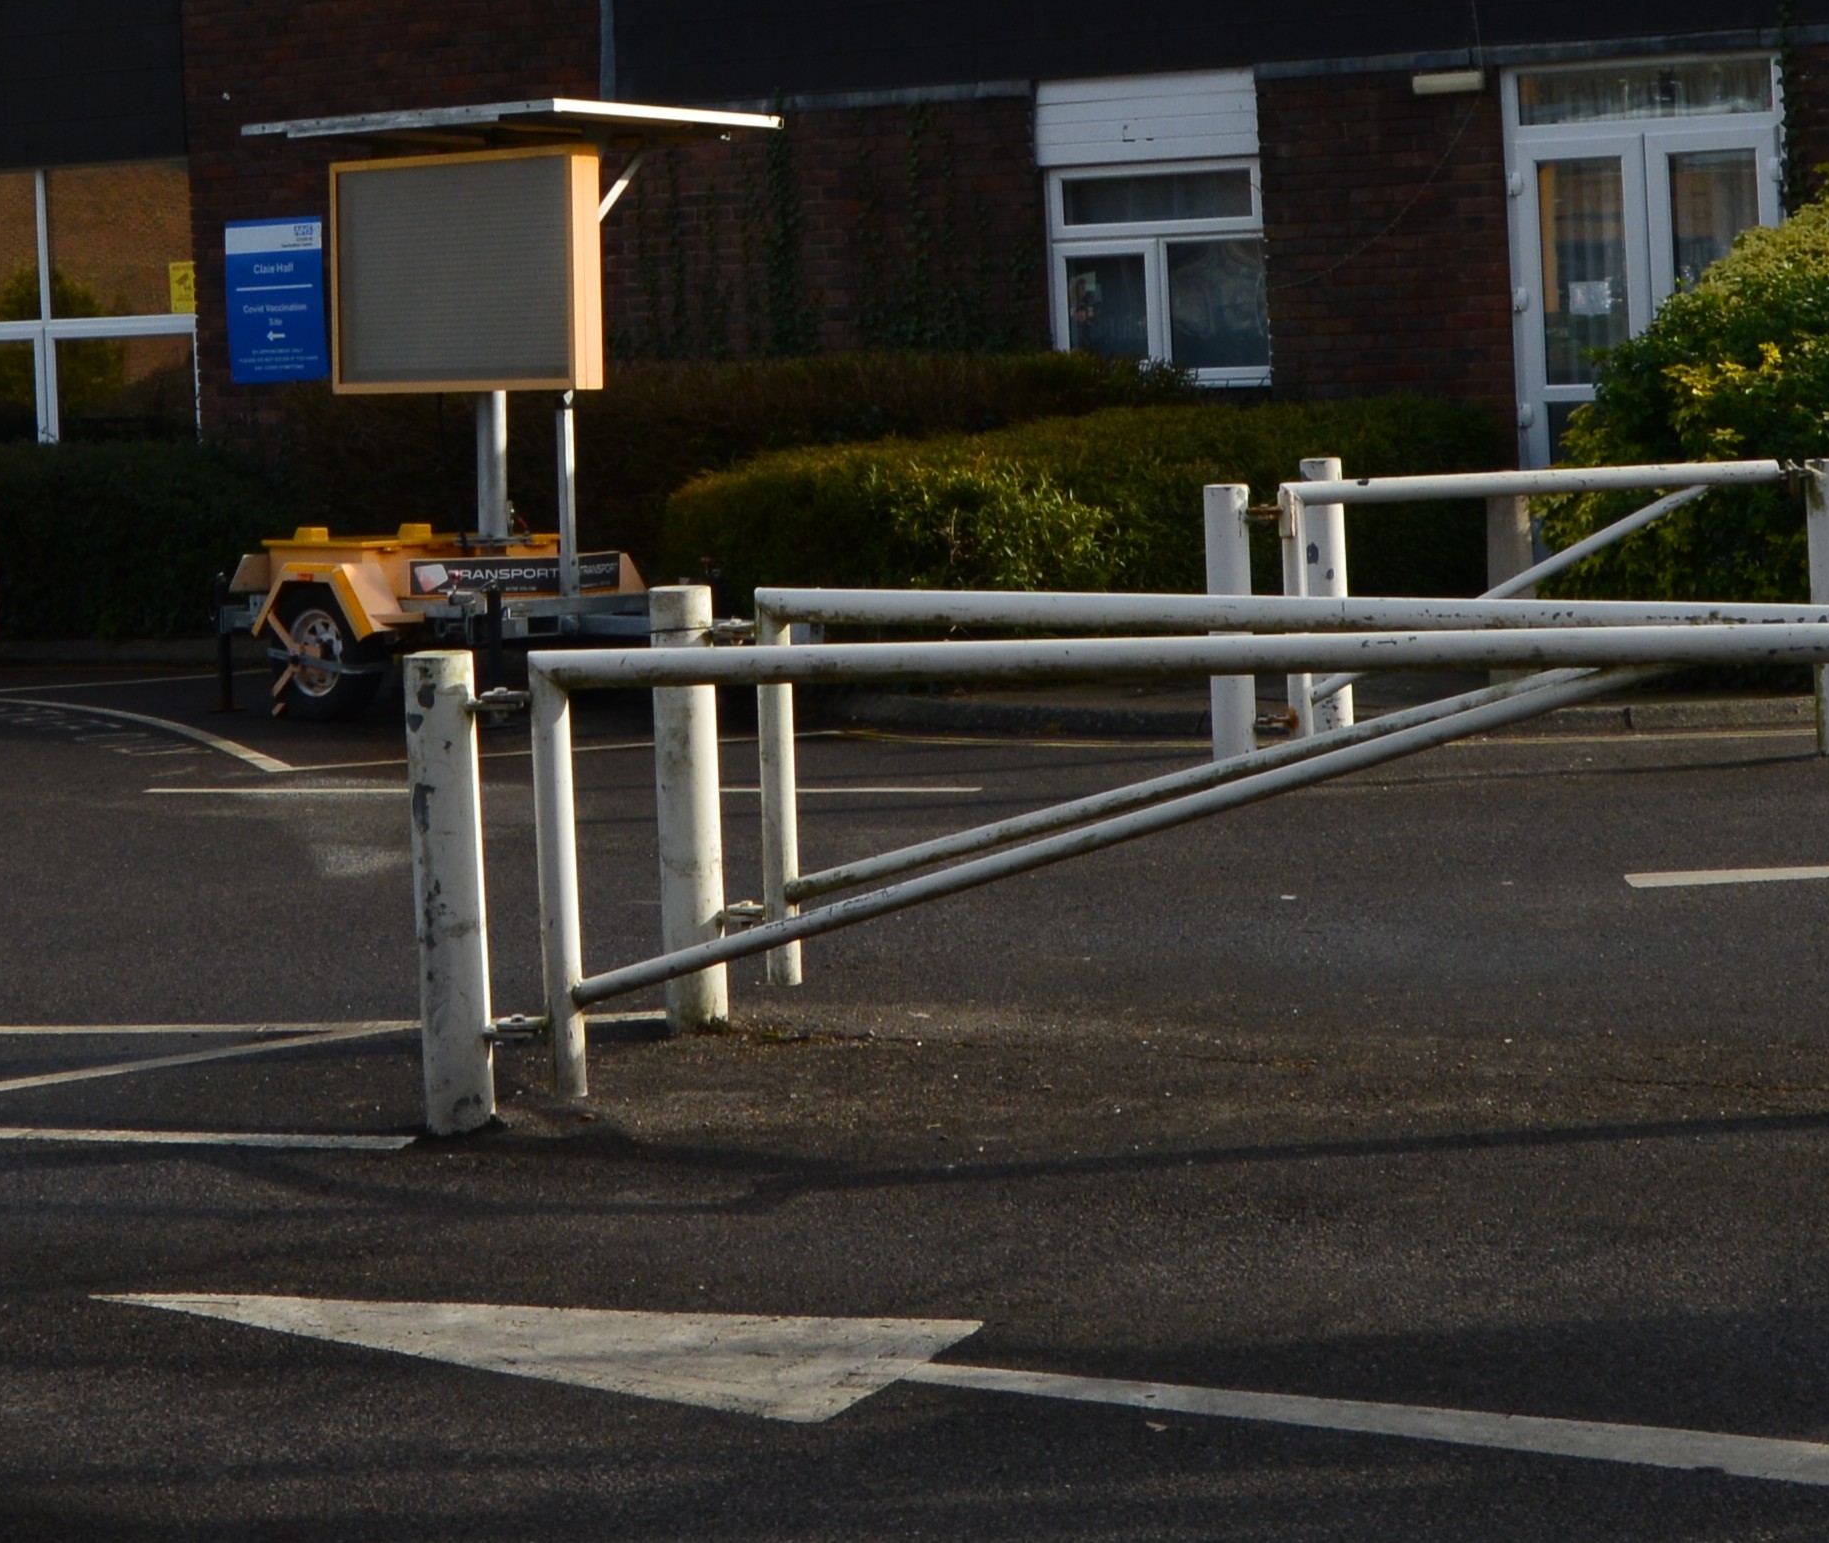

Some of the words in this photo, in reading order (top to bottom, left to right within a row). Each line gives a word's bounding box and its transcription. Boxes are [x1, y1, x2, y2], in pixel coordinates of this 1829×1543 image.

[294, 225, 313, 236] NHS
[276, 262, 294, 273] Hall
[243, 305, 264, 314] Covid
[265, 304, 307, 313] Vaccination
